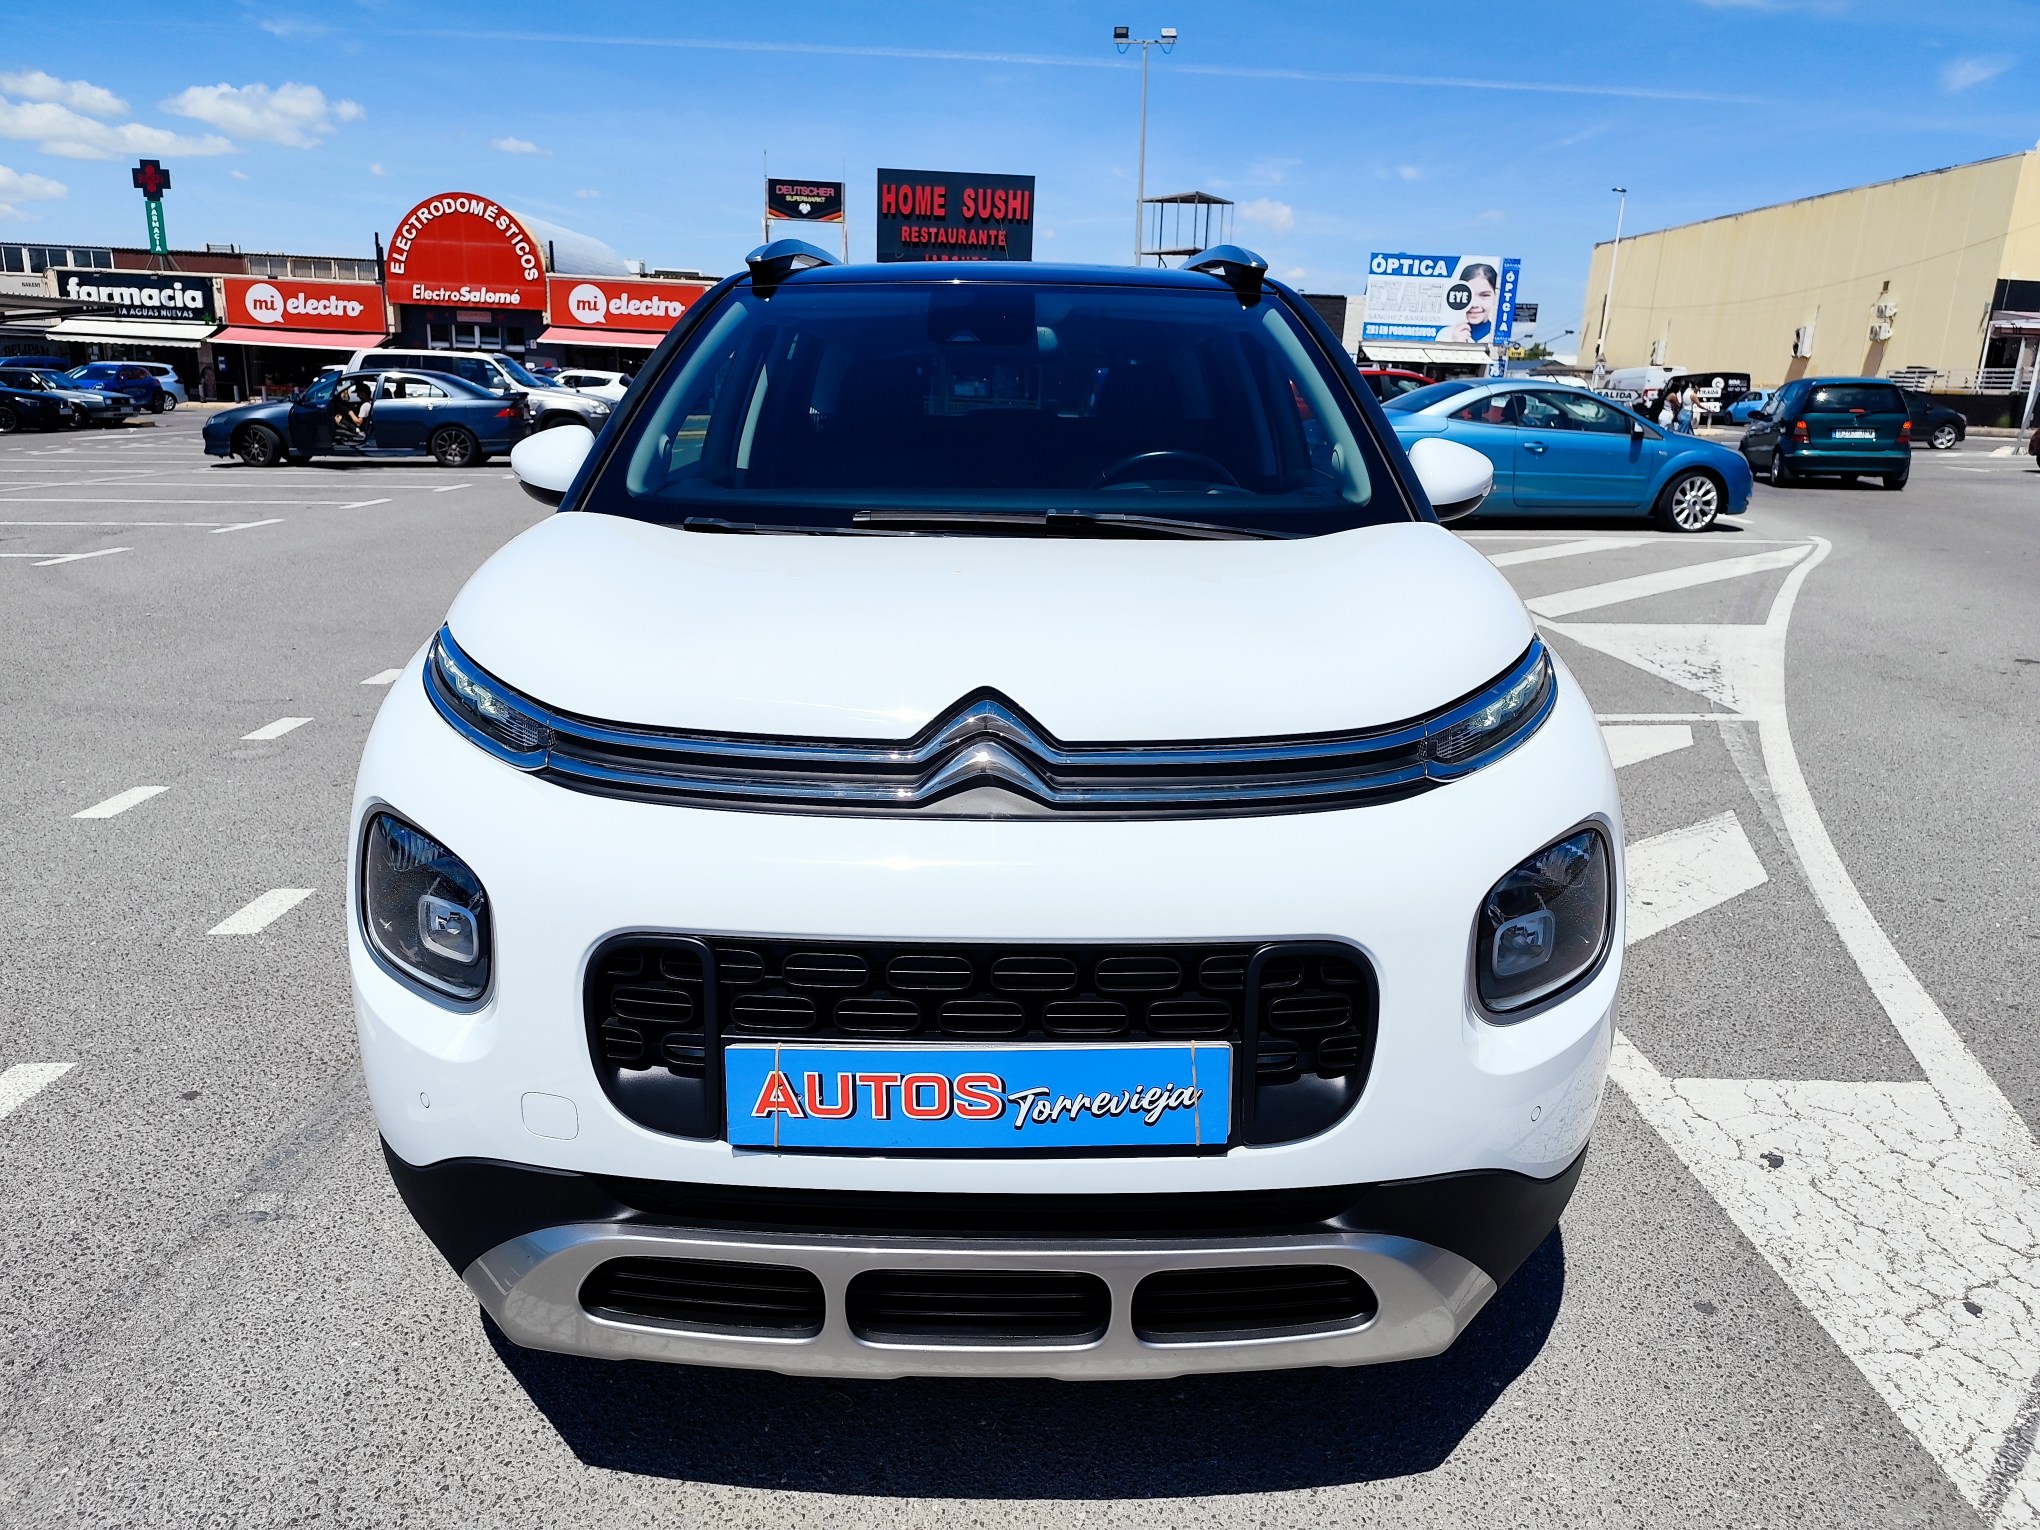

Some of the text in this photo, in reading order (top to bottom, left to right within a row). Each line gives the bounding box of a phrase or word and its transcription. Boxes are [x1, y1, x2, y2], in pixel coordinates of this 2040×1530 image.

[775, 185, 834, 197] DEUTSCHER
[785, 195, 826, 203] SUPERMARKT
[882, 184, 1030, 220] HOME SUSHI
[150, 202, 162, 252] FARMACIA
[901, 226, 1006, 246] RESTAURANTE
[390, 198, 539, 281] ELECTRODOMÉSTICOS
[1371, 254, 1448, 276] ÓPTICA
[66, 277, 204, 309] farmacia
[253, 292, 364, 317] mi electro
[412, 284, 521, 304] ElectroSalomé
[1448, 291, 1469, 303] EYE
[129, 307, 159, 316] AGUAS
[160, 309, 194, 318] NUEVAS
[576, 293, 685, 318] mi electro
[751, 1070, 1203, 1128] AUTOS Torrevieja
